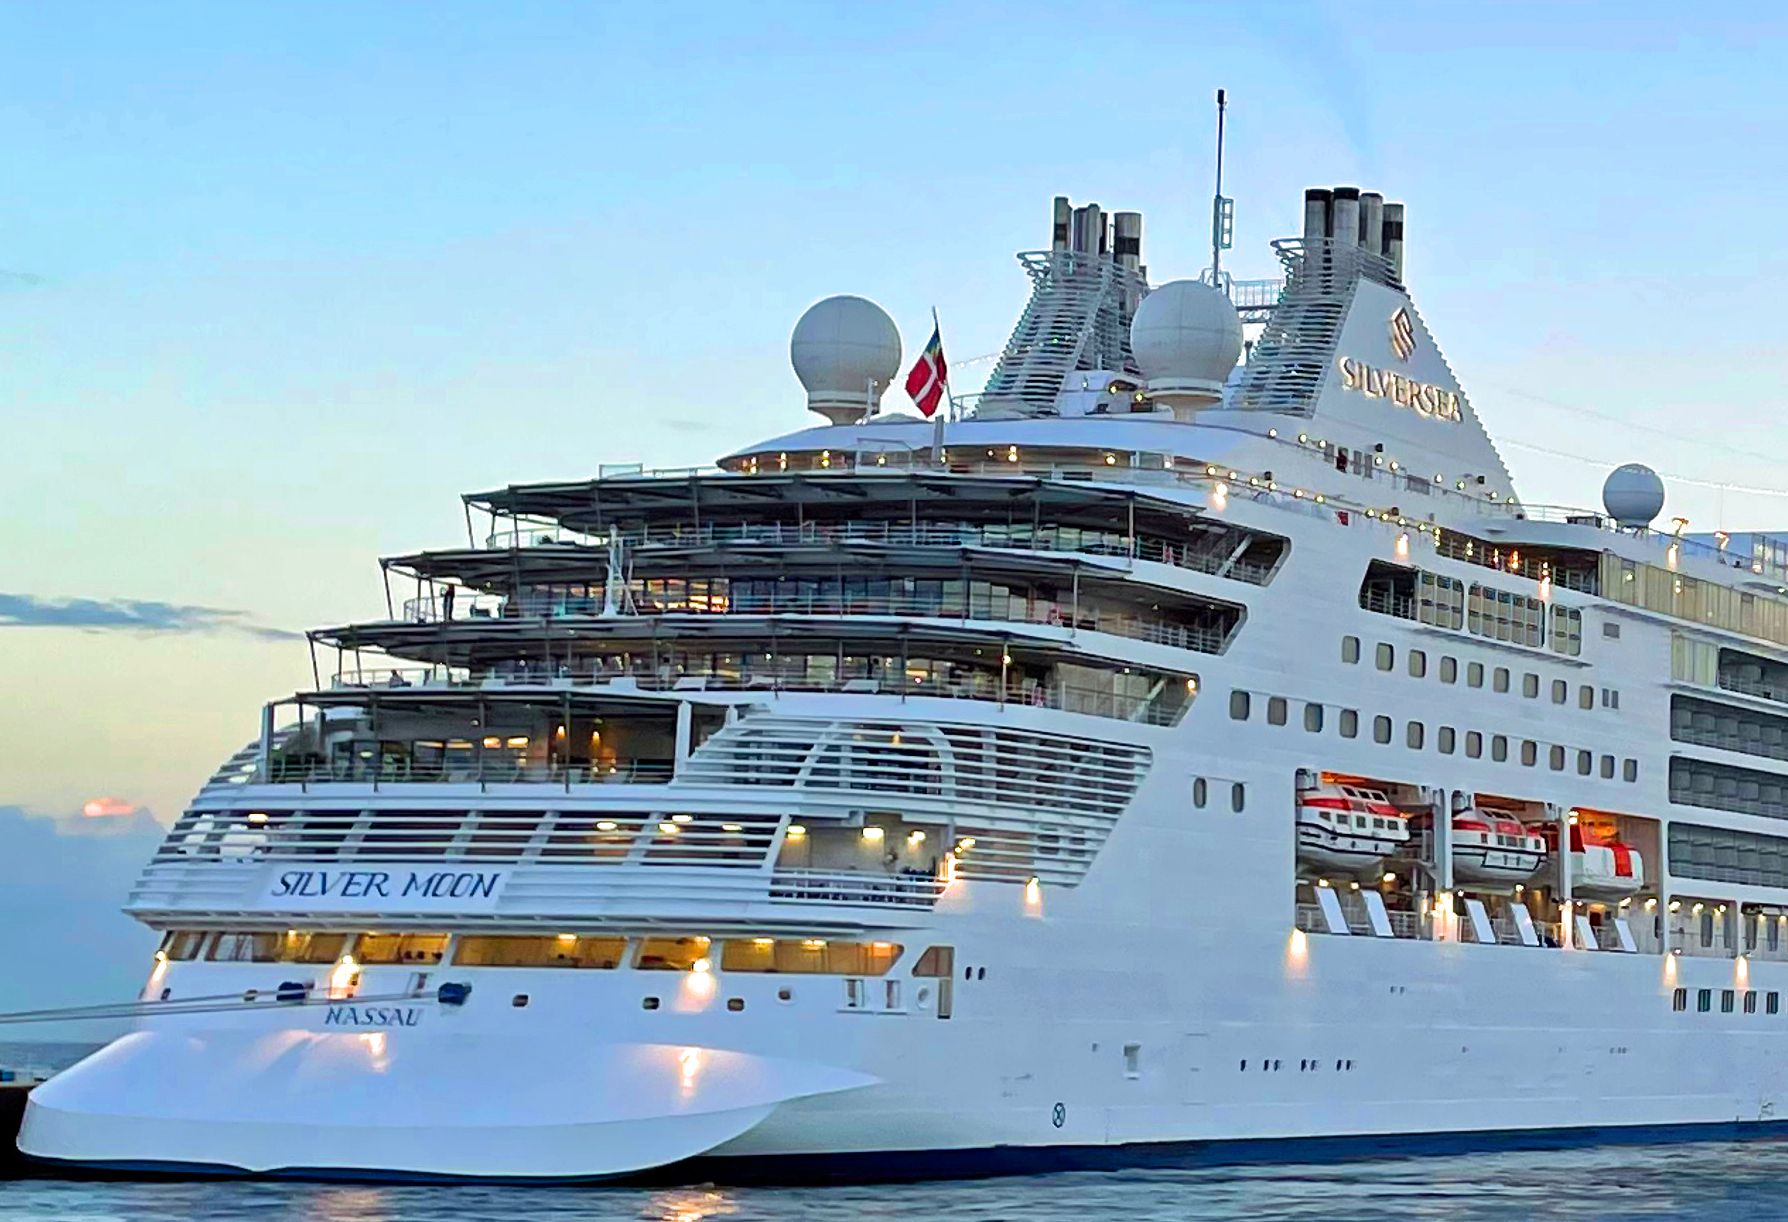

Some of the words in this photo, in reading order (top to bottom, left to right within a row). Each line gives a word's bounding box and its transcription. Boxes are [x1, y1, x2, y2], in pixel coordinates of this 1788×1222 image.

[1339, 355, 1463, 423] SILVERSEA
[271, 870, 390, 898] SILVER
[401, 871, 501, 898] MOON
[325, 1006, 422, 1027] NASSAU
